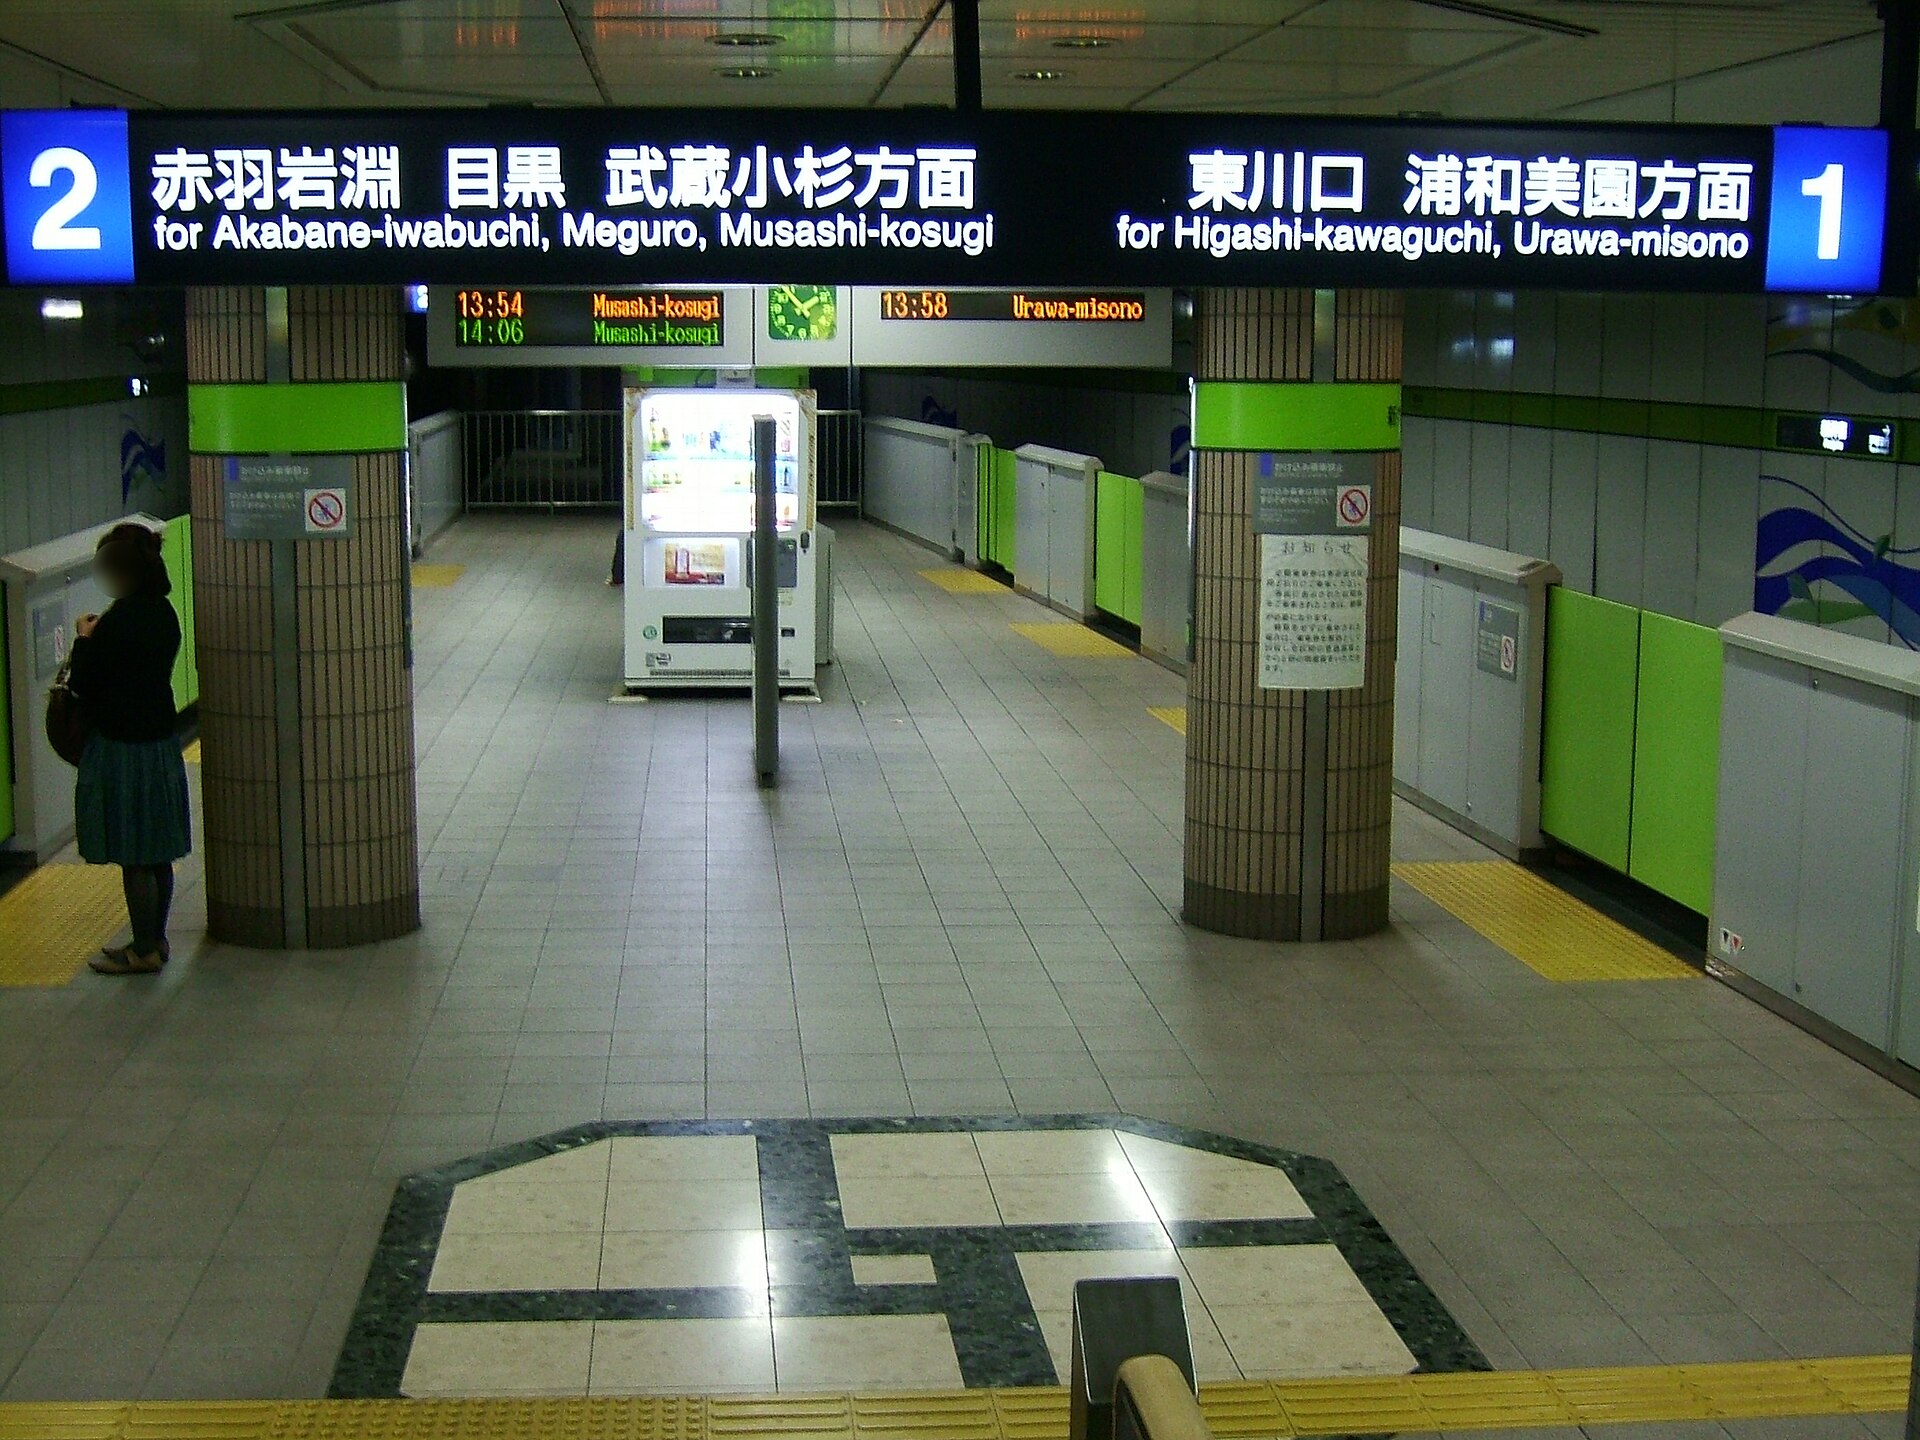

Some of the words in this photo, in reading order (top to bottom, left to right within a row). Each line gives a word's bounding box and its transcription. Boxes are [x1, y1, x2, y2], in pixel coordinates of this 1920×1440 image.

[30, 147, 101, 250] 2
[152, 146, 401, 211] 赤羽岩淵
[447, 146, 566, 209] 目黒
[605, 145, 977, 210] 武蔵小杉方面
[1188, 150, 1364, 213] 東川口
[1403, 154, 1753, 222] 浦和美園方面
[154, 215, 203, 250] for
[213, 213, 549, 252] Akabane-iwabuchi,
[563, 213, 707, 256] Meguro,
[720, 213, 994, 256] Musashi-kosugi
[1802, 163, 1843, 260] 1
[1117, 215, 1164, 249] for
[1174, 217, 1501, 261] Higashi-kawaguchi,
[1512, 219, 1750, 260] Urawa-misono
[459, 291, 524, 318] 13:54
[593, 293, 720, 320] Musashi-kosugi
[883, 292, 947, 318] 13:58
[1013, 294, 1142, 319] Urawa-misono
[459, 319, 524, 344] 14:06
[593, 320, 720, 346] Musashi-kosugi
